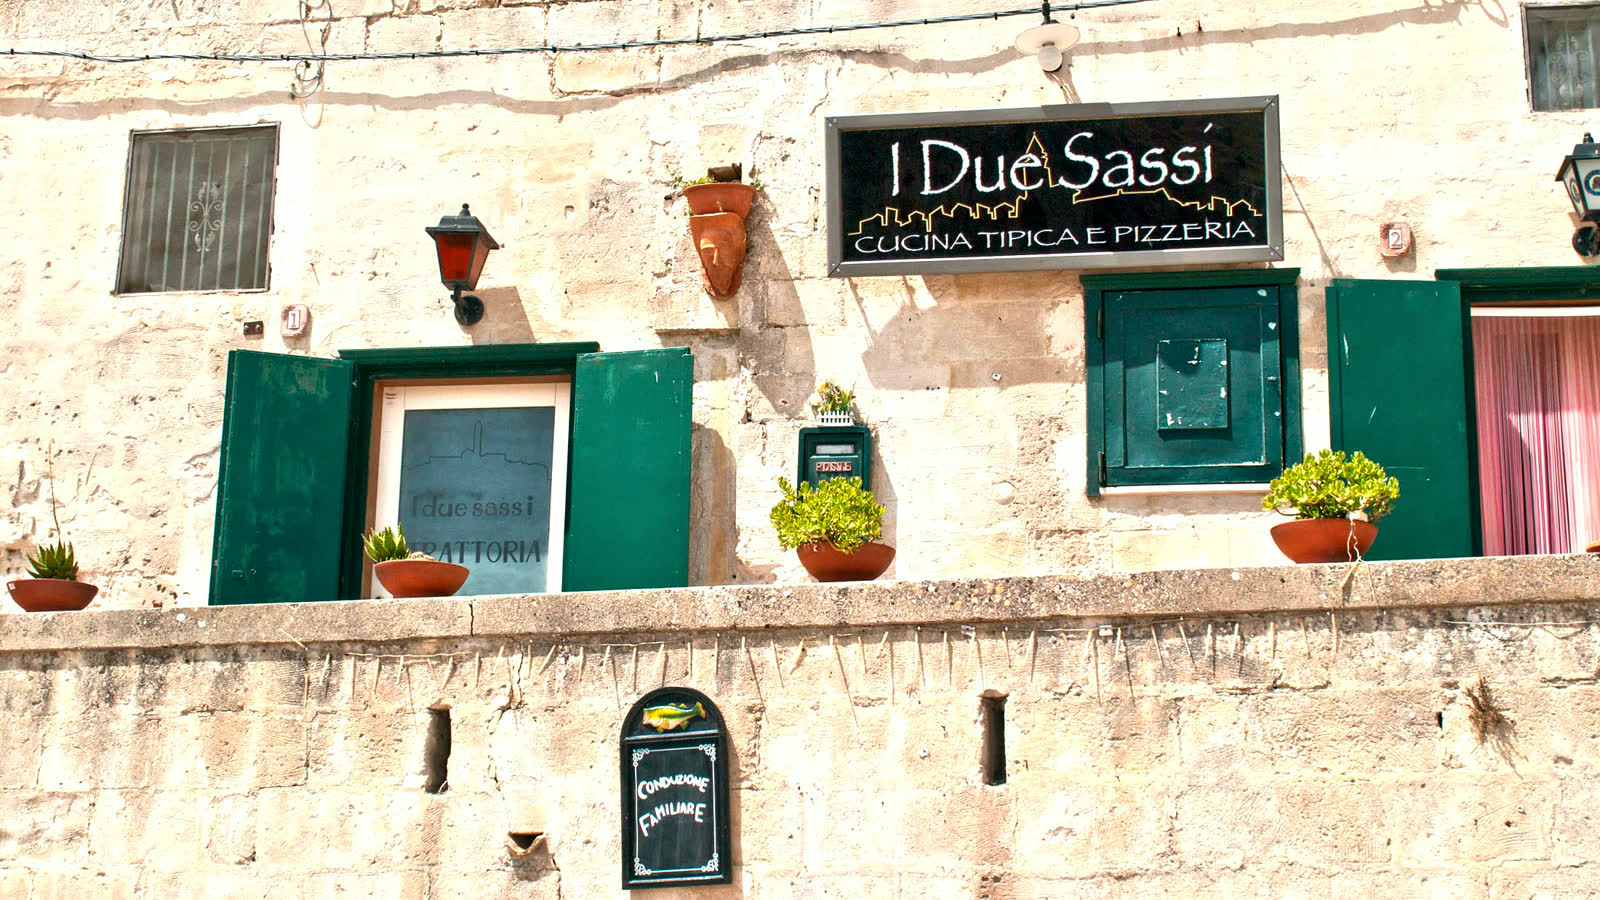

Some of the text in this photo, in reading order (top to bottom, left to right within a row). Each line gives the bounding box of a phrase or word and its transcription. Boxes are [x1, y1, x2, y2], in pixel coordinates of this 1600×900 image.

[891, 140, 900, 197] I
[919, 138, 1044, 196] Due
[854, 220, 1257, 254] CUCINA TIPICA E PIZZERIA
[1390, 231, 1401, 247] 2
[815, 461, 852, 472] POSTE
[422, 495, 468, 518] due
[472, 495, 535, 517] sassi
[638, 774, 710, 800] CONDUZIONE
[638, 802, 706, 837] FAMILIARE
